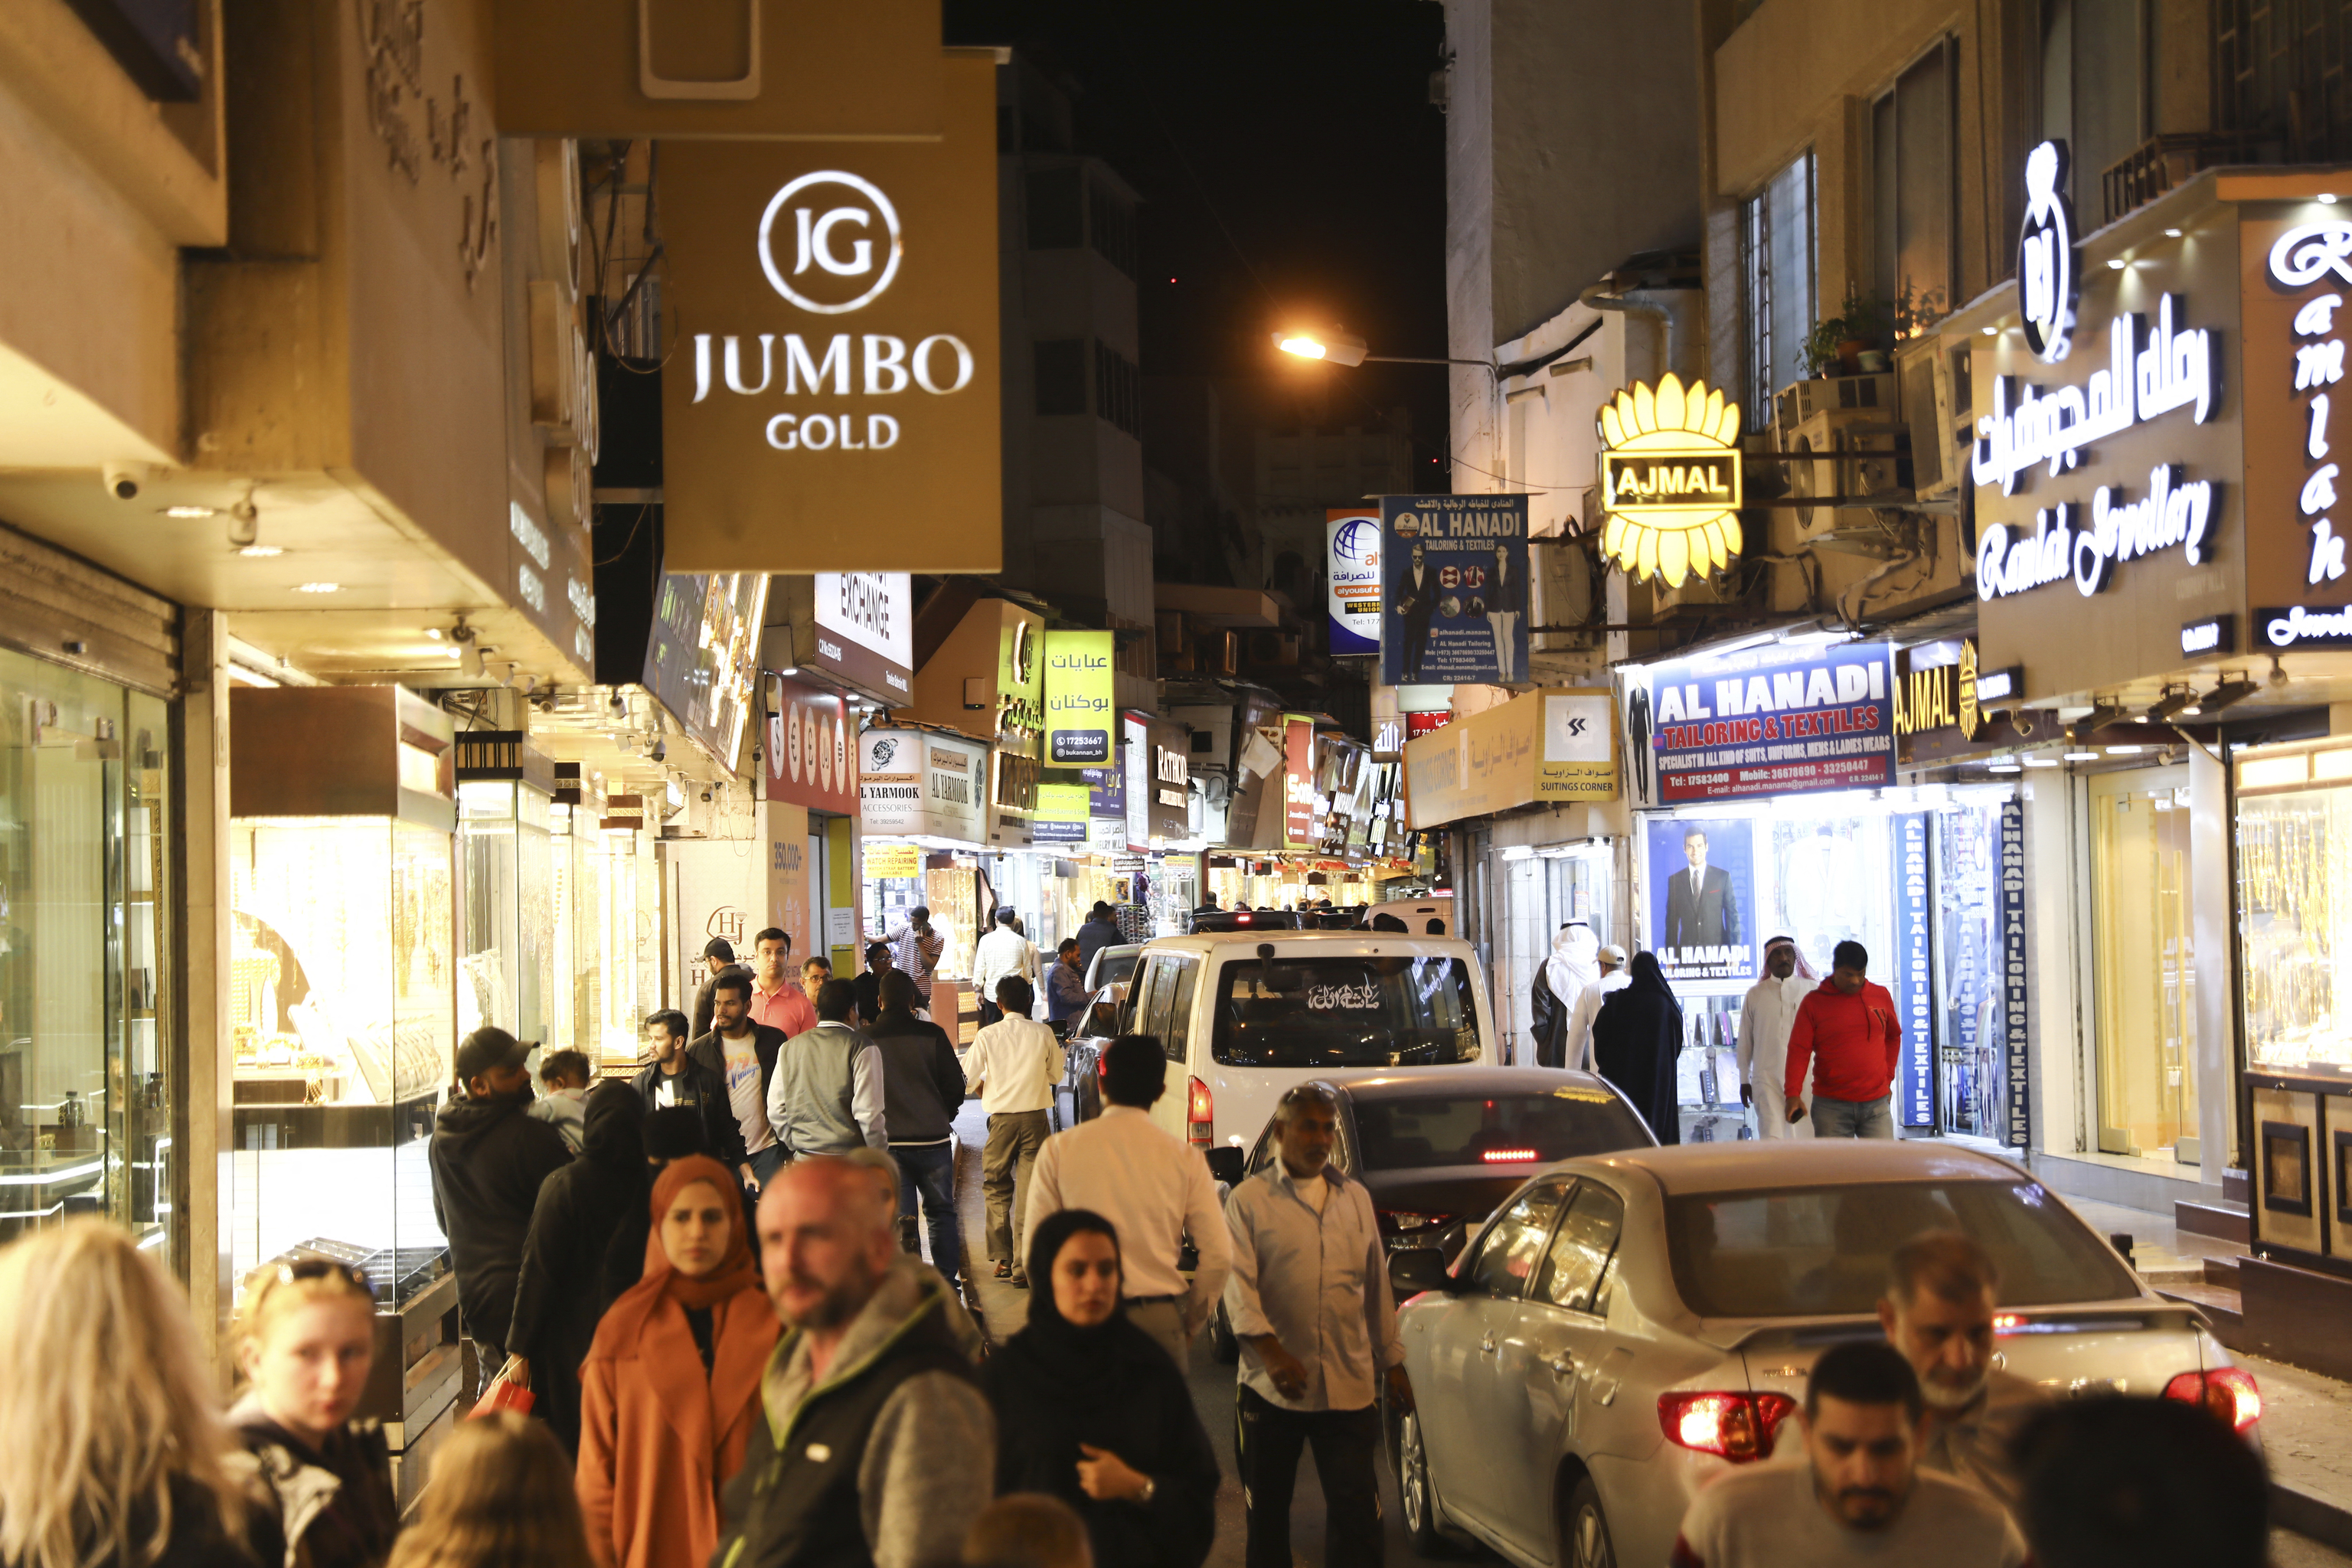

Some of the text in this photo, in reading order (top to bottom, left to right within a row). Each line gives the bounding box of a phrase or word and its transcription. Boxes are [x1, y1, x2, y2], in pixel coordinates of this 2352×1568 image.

[793, 206, 872, 276] JG
[691, 333, 975, 404] JUMBO
[766, 413, 900, 451] GOLD
[1617, 466, 1729, 495] AJMAL
[1419, 512, 1520, 537] AL HANADI
[1976, 463, 2210, 602] Ramlah Jewellery
[1425, 540, 1494, 551] TAILORING & TEXTILES
[1333, 571, 1374, 582] للصرافة
[1338, 586, 1373, 595] alyousuf
[841, 571, 890, 641] EXCHANGE
[1051, 654, 1107, 671] عبايات
[1050, 694, 1109, 712] بوكنان
[1658, 661, 1884, 723] AL HANADI
[1893, 665, 1955, 736] AJMAL
[1663, 705, 1879, 750] TAILORING & TEXTILES
[1157, 744, 1187, 786] RATHOD
[1658, 735, 1890, 770] SPECIALIST IN ALL KIND OF SUITS, UNIFORMS, MENS & LADIES WEARS
[1434, 746, 1457, 792] CORNER
[1542, 768, 1613, 778] اصواف الزاوية
[1670, 776, 1686, 786] Tel:
[1687, 773, 1729, 786] 17583400
[1740, 765, 1770, 781] Mobile:
[1771, 765, 1815, 780] 36678690
[1824, 760, 1868, 775] 33250447
[1861, 773, 1883, 782] 22414-7
[870, 787, 920, 799] YARMOOK
[932, 773, 968, 804] AL YARMOOK
[1541, 782, 1613, 791] SUITINGS CORNER
[1707, 777, 1835, 794] E-mail: alhanadi.manama@gmail.com
[862, 804, 913, 812] ACCESSORIES
[774, 841, 802, 874] 350,000+
[1656, 945, 1750, 965] AL HANADI
[1661, 965, 1752, 978] AILORING & TEXTILES
[725, 1063, 760, 1089] Vintage
